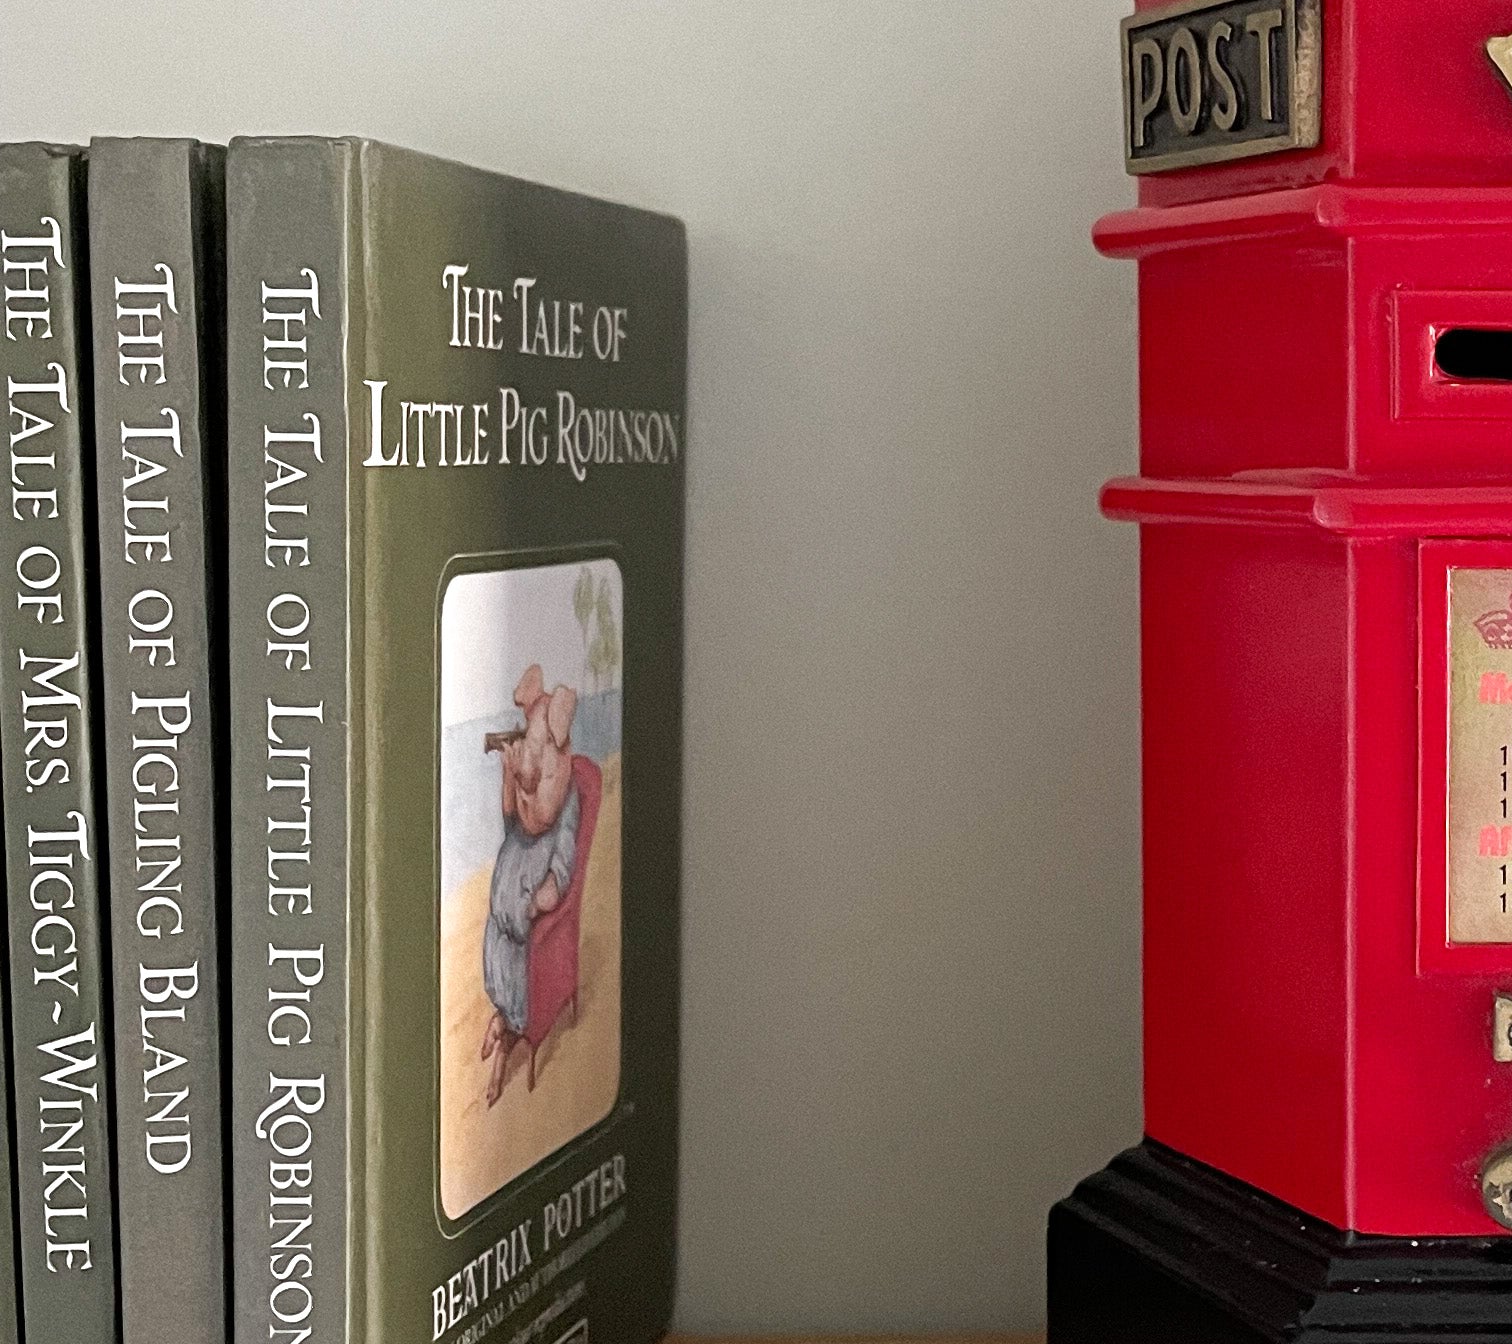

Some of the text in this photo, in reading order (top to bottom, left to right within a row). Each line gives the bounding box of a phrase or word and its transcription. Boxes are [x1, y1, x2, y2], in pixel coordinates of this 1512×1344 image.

[1133, 8, 1282, 147] POST
[1, 216, 66, 342] THE
[261, 268, 322, 391] THE
[443, 264, 628, 362] THE TALE OF
[7, 362, 72, 522] TALE
[264, 413, 324, 568] TALE
[362, 379, 680, 482] LITTLE PIG ROBINSON
[16, 546, 64, 625] OF
[265, 593, 311, 672] OF
[18, 650, 82, 795] MRS.
[114, 263, 199, 1175] THE TALE OF PIGLING BLAND
[265, 696, 325, 917] LITTLE
[267, 943, 325, 1047] PIG
[432, 1219, 532, 1342] BEATRIX
[543, 1155, 627, 1252] POTTER
